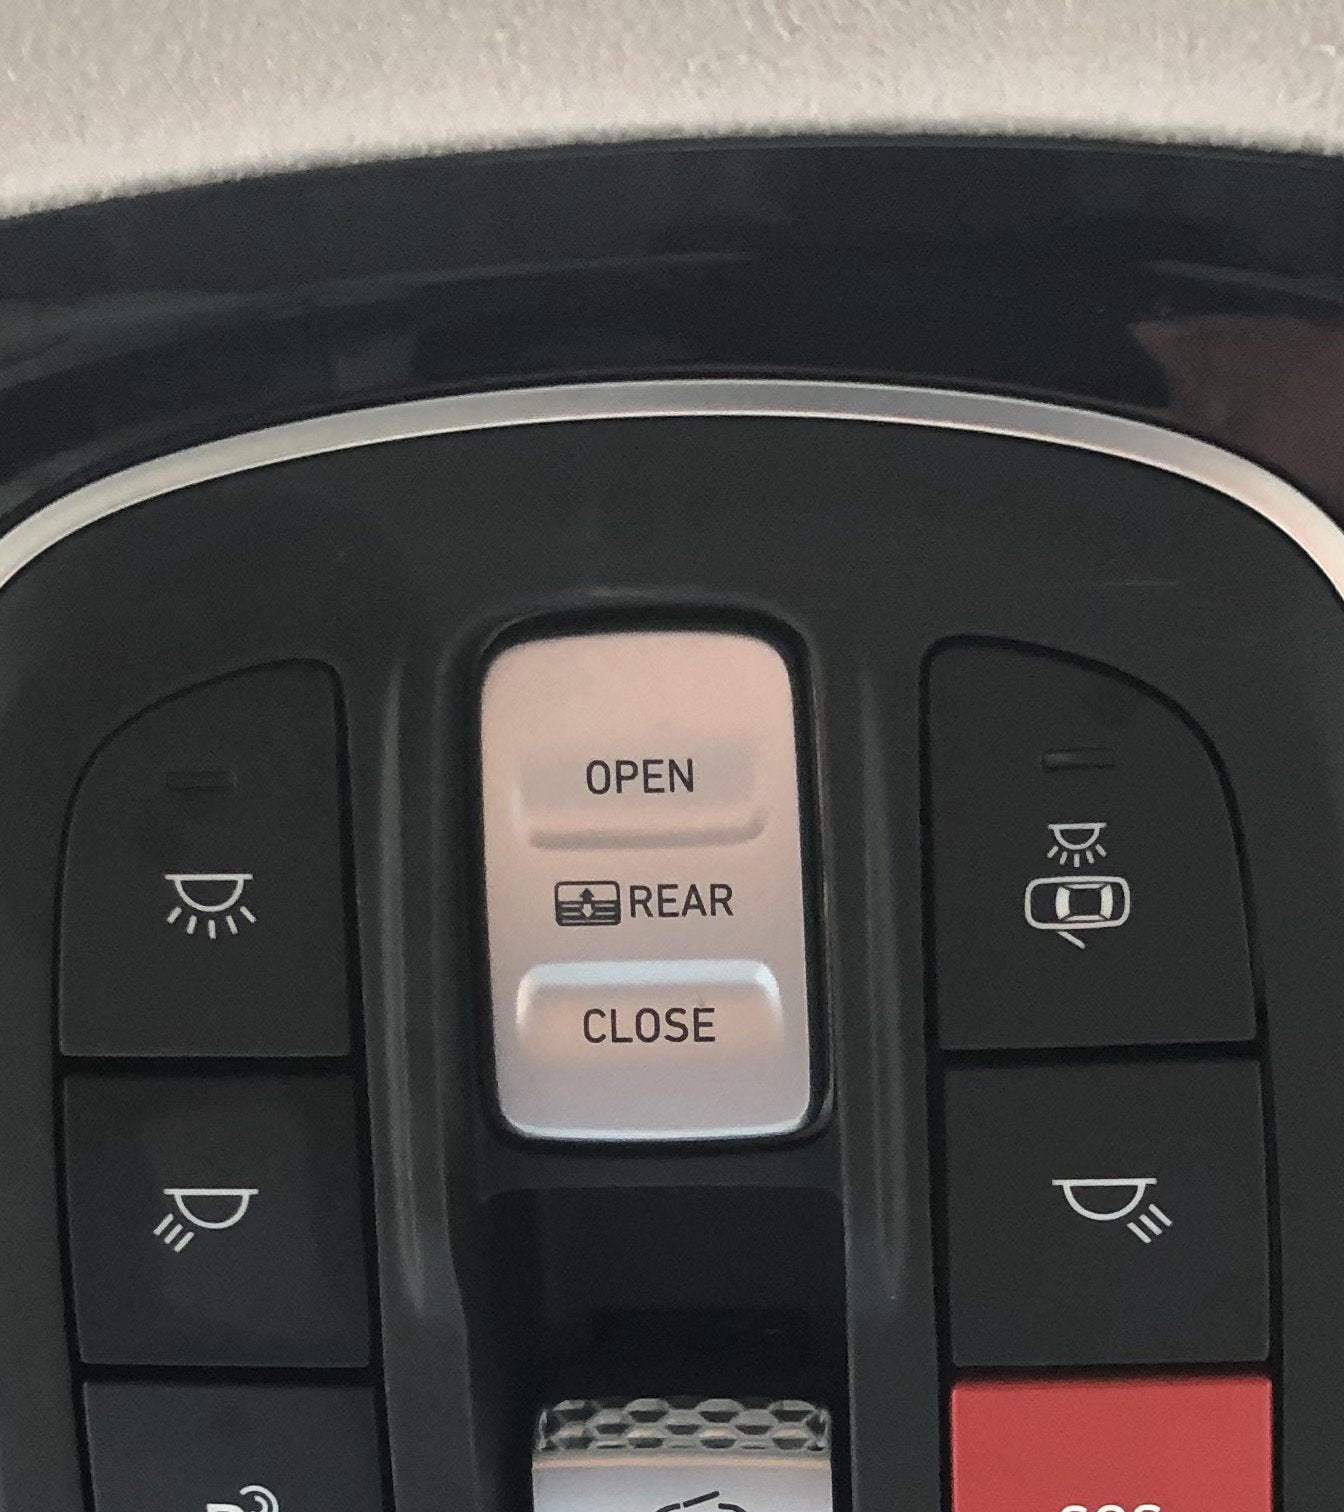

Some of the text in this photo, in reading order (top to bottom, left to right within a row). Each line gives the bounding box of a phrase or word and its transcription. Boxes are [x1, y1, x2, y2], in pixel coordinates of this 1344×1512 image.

[586, 759, 695, 795] OPEN
[629, 883, 734, 918] REAR
[583, 1007, 716, 1043] CLOSE
